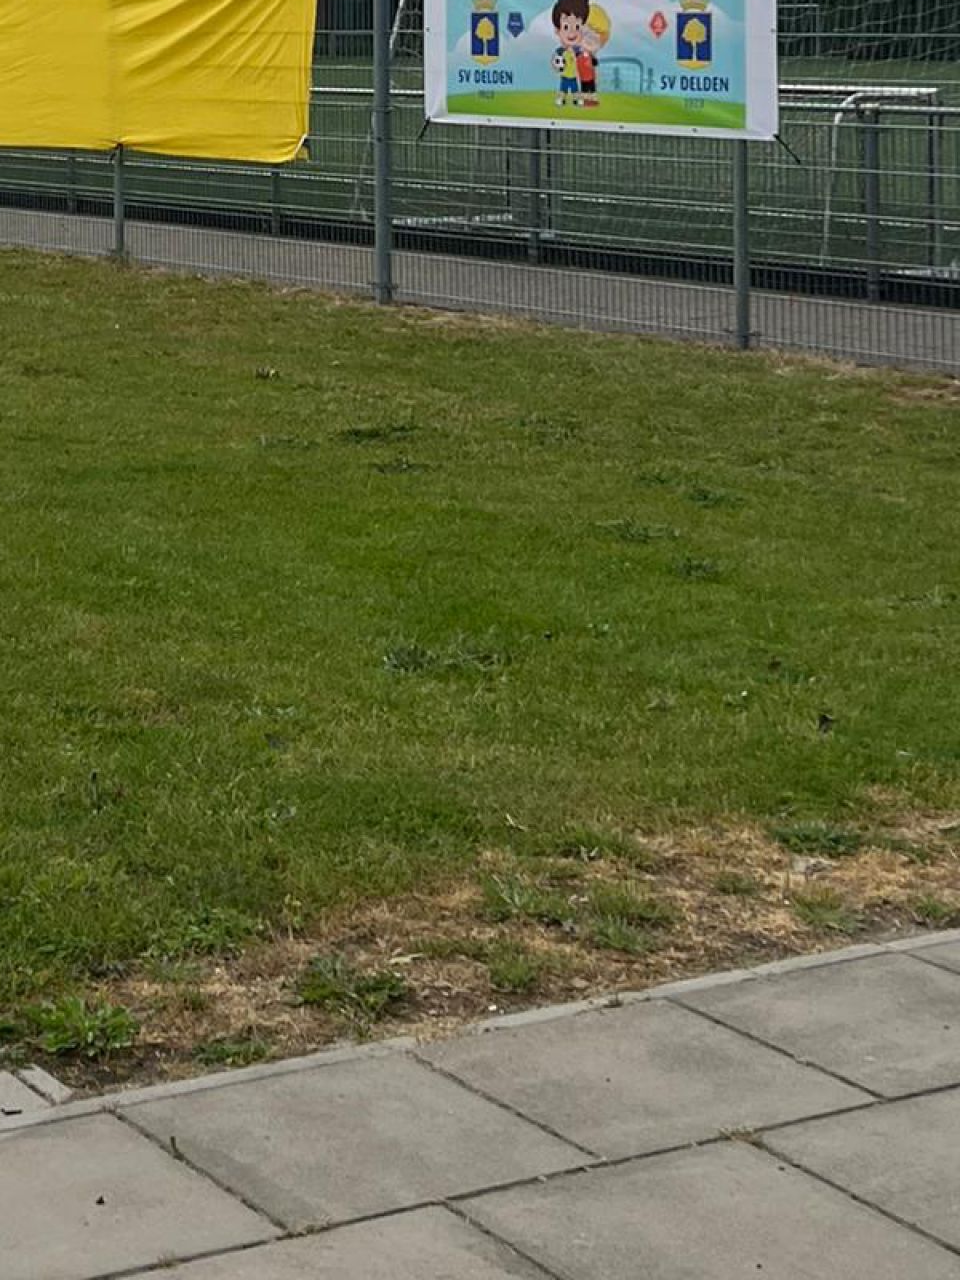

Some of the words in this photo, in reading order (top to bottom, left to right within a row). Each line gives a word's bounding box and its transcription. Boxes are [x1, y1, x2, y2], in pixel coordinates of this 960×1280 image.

[458, 69, 471, 84] SV
[474, 70, 513, 85] DELDEN
[660, 74, 676, 91] SV
[680, 76, 729, 92] DELDEN
